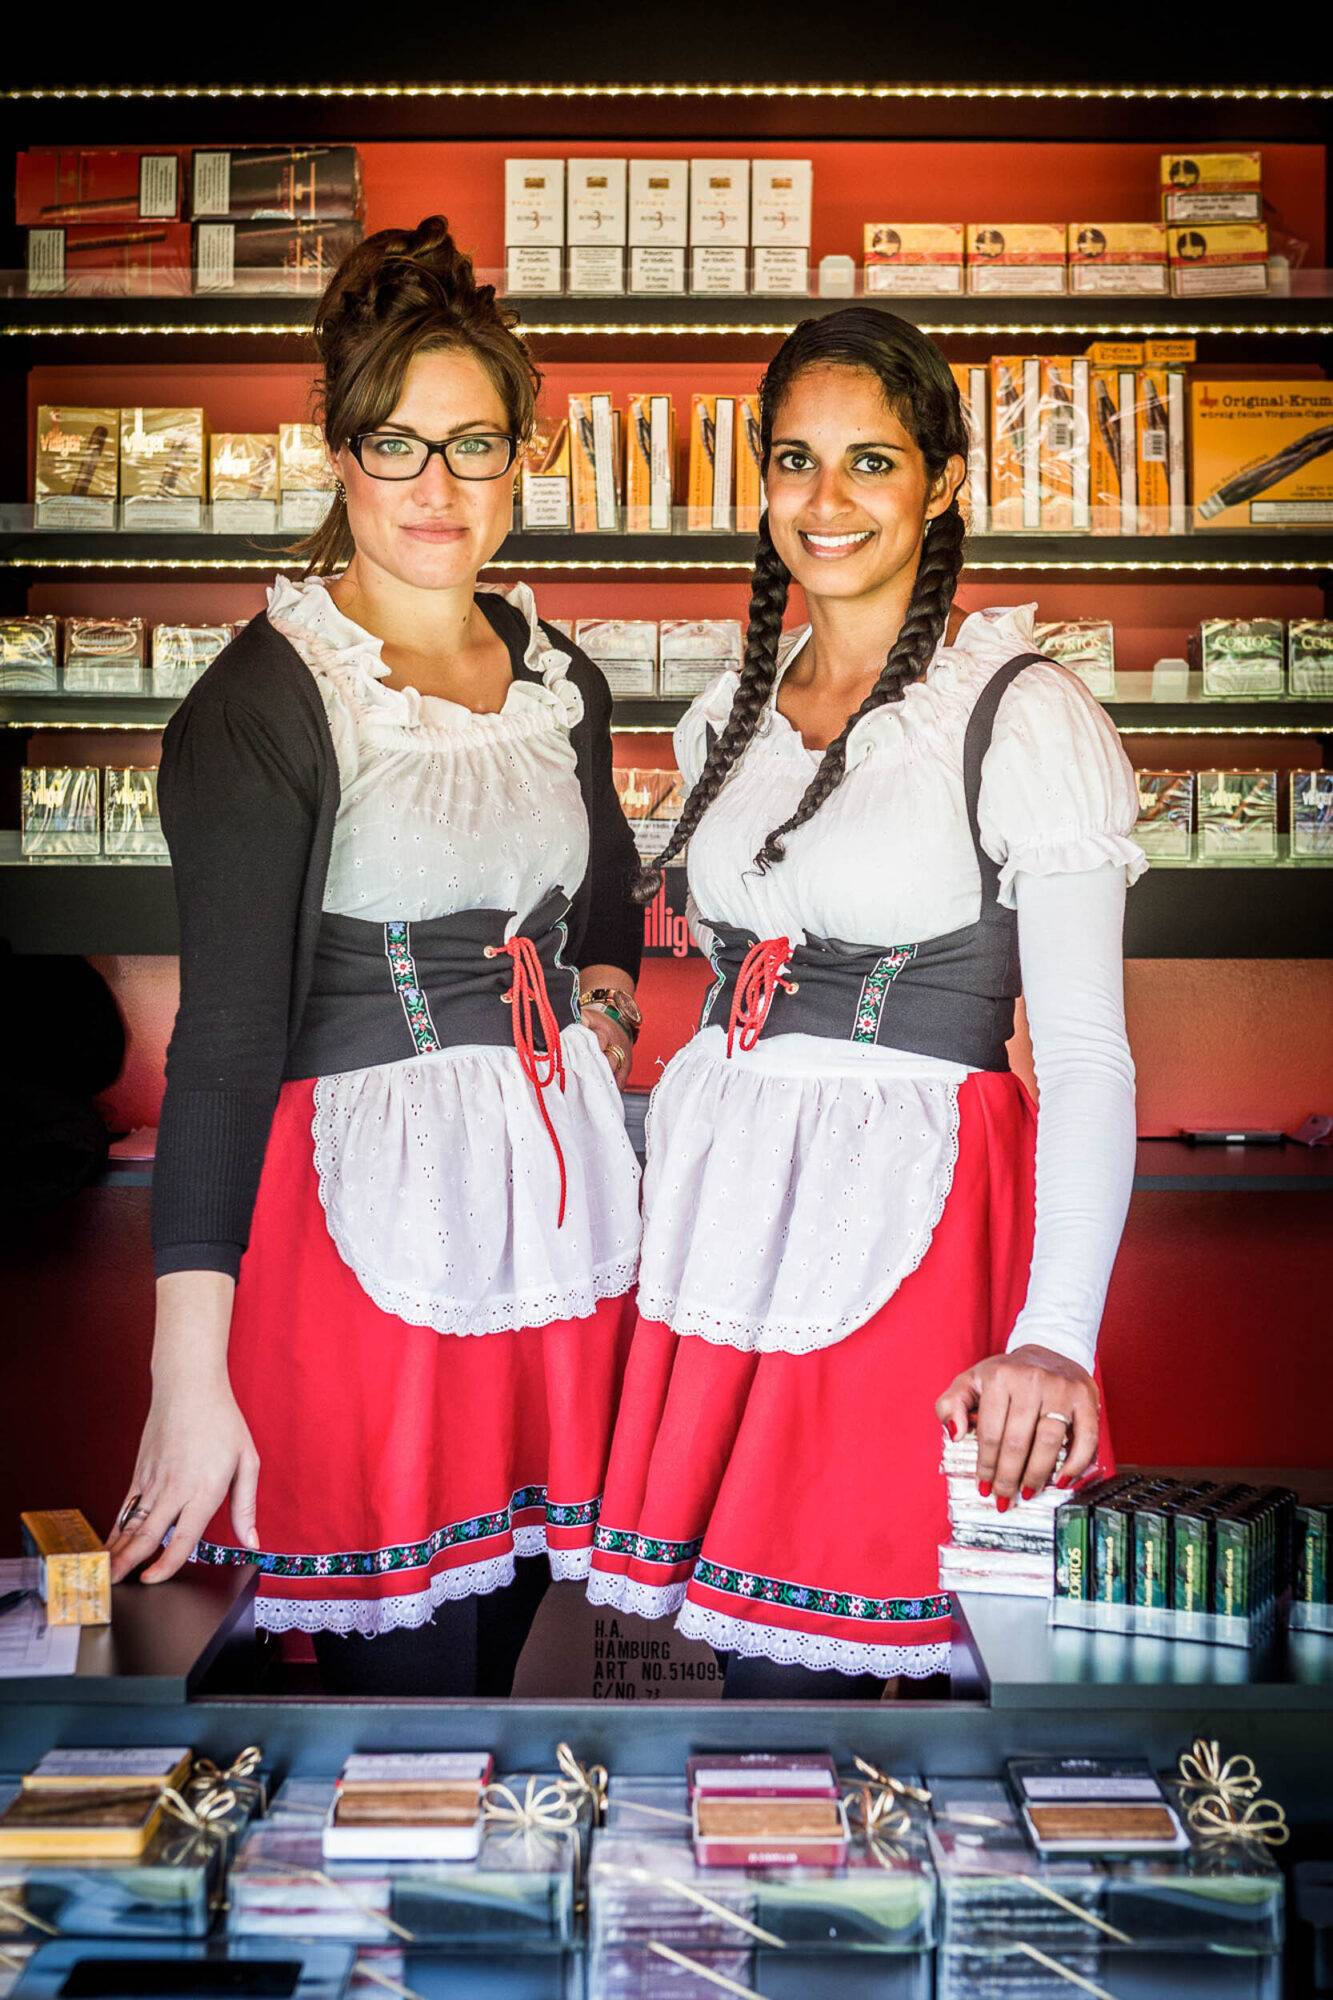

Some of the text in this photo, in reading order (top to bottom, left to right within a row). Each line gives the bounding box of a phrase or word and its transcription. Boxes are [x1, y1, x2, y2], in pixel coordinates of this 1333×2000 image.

[1215, 634, 1272, 652] CORTOS
[644, 869, 698, 958] illig
[595, 1619, 624, 1639] H.A.
[595, 1640, 670, 1660] HAMBURG
[594, 1661, 627, 1680] ART
